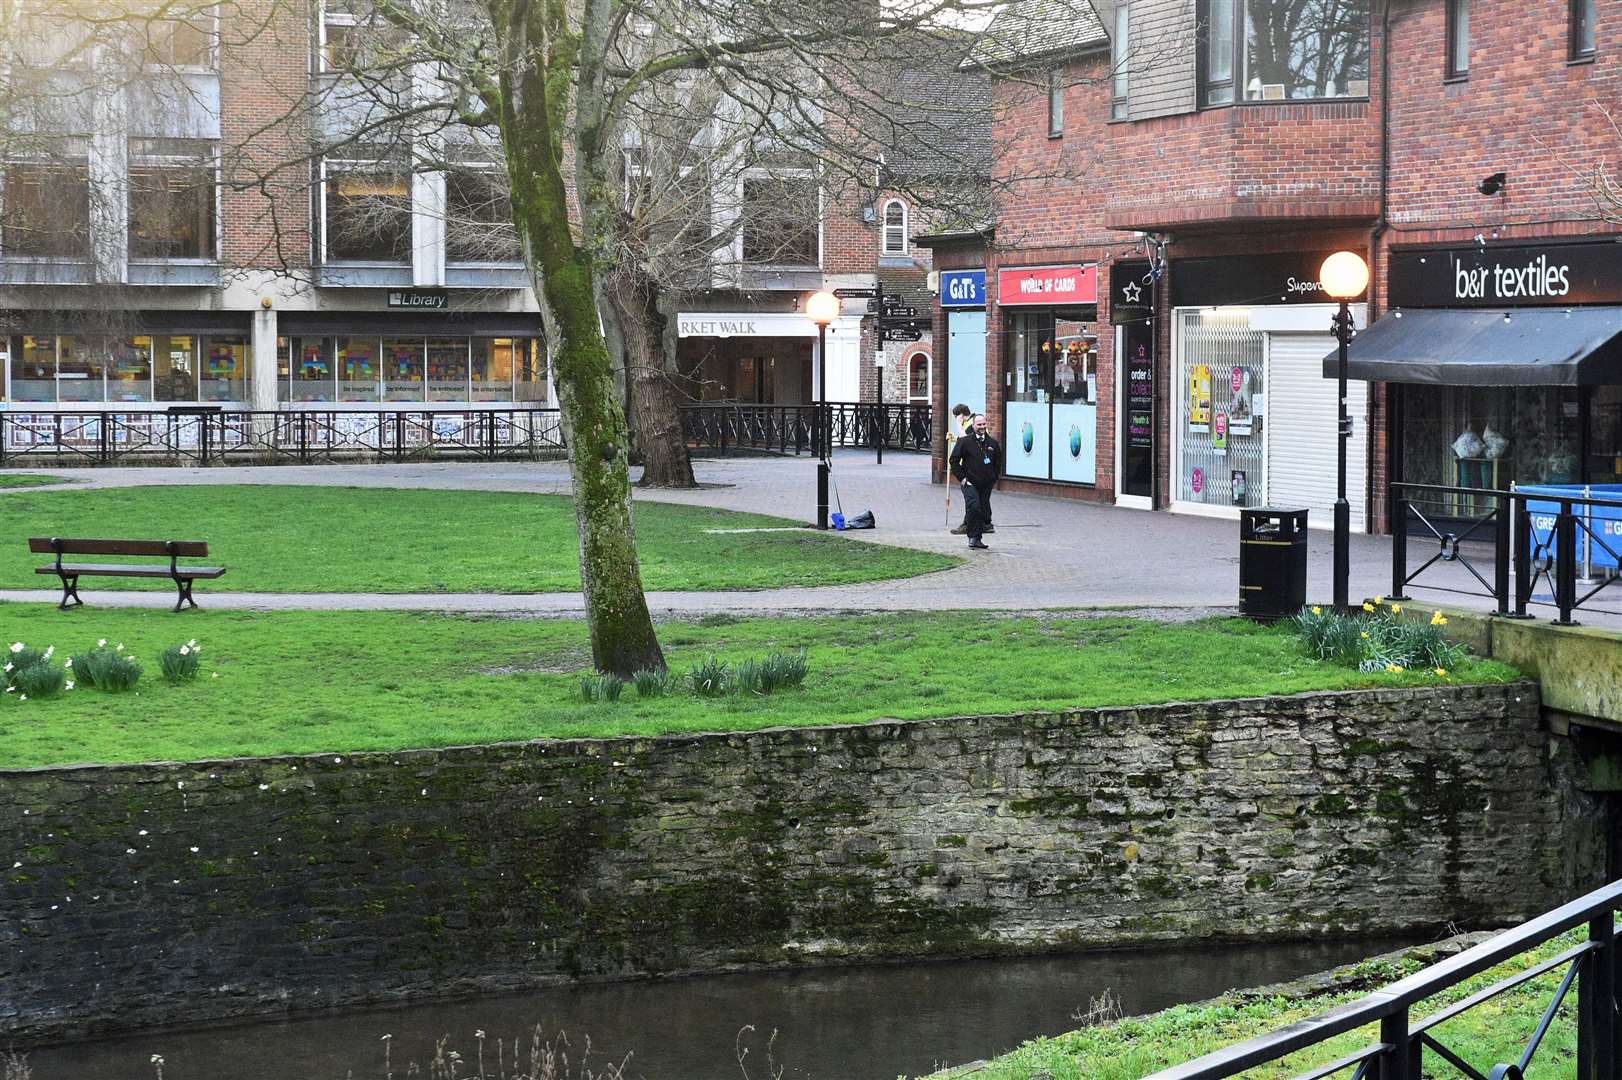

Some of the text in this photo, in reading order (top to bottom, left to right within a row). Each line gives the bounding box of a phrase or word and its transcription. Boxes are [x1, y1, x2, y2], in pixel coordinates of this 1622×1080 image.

[1456, 254, 1569, 298] b&r textiles
[1020, 277, 1076, 293] WORLD OF CARDS
[402, 293, 446, 308] Library
[680, 321, 756, 334] RKET WALK
[1131, 369, 1146, 380] order
